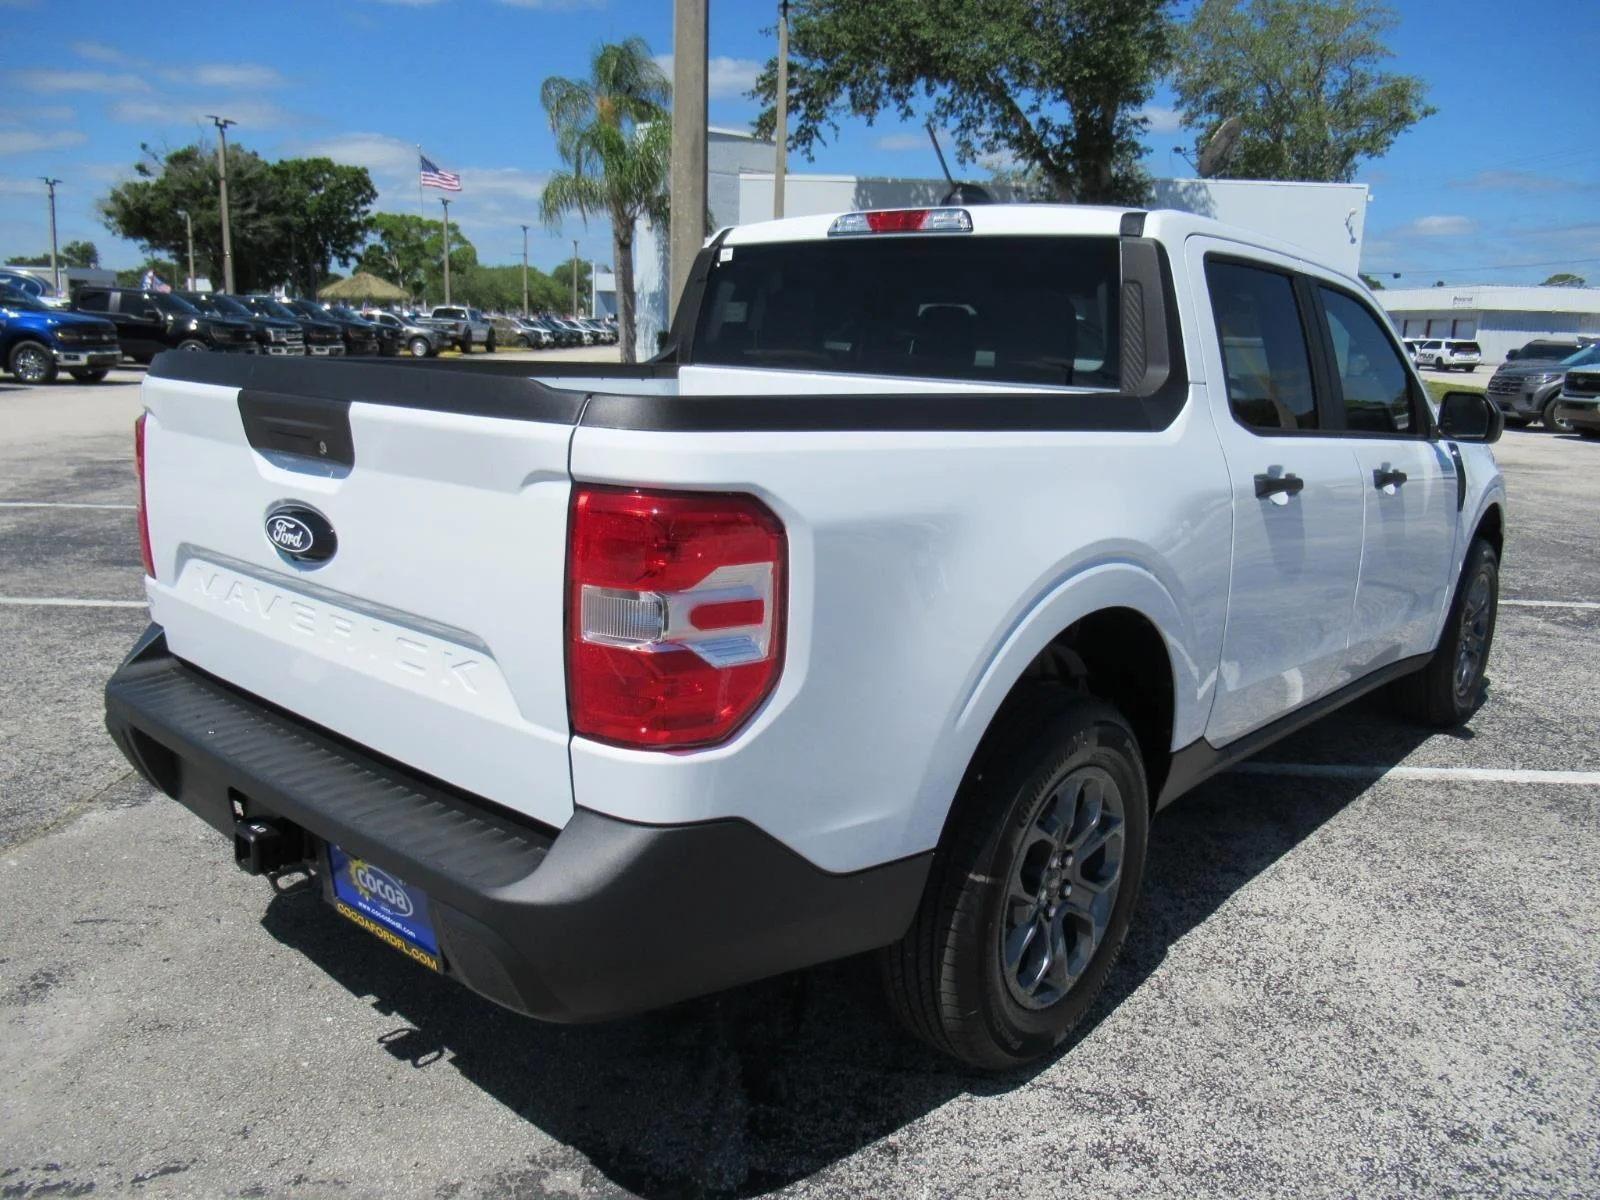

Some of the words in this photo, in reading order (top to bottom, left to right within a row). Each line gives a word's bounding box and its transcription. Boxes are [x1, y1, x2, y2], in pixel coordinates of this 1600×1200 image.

[273, 519, 304, 548] Ford
[194, 565, 480, 696] MAVERICK
[336, 903, 438, 971] COCOAFORDFL.COM
